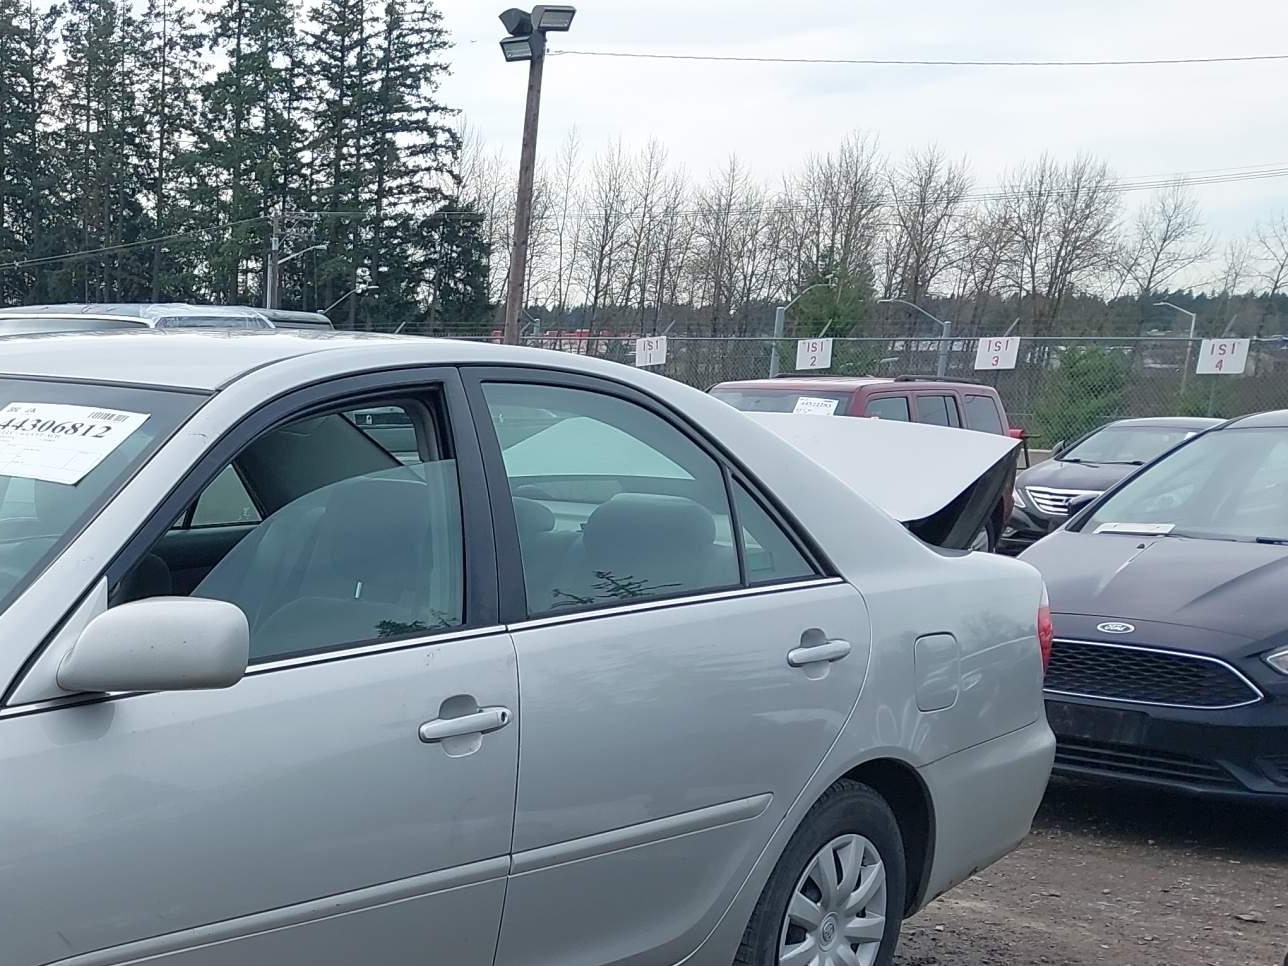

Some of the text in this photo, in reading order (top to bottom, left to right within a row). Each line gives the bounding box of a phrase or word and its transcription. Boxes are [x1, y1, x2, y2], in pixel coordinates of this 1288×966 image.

[809, 355, 817, 367] 2
[991, 355, 1000, 367] 3
[1215, 359, 1224, 372] 4
